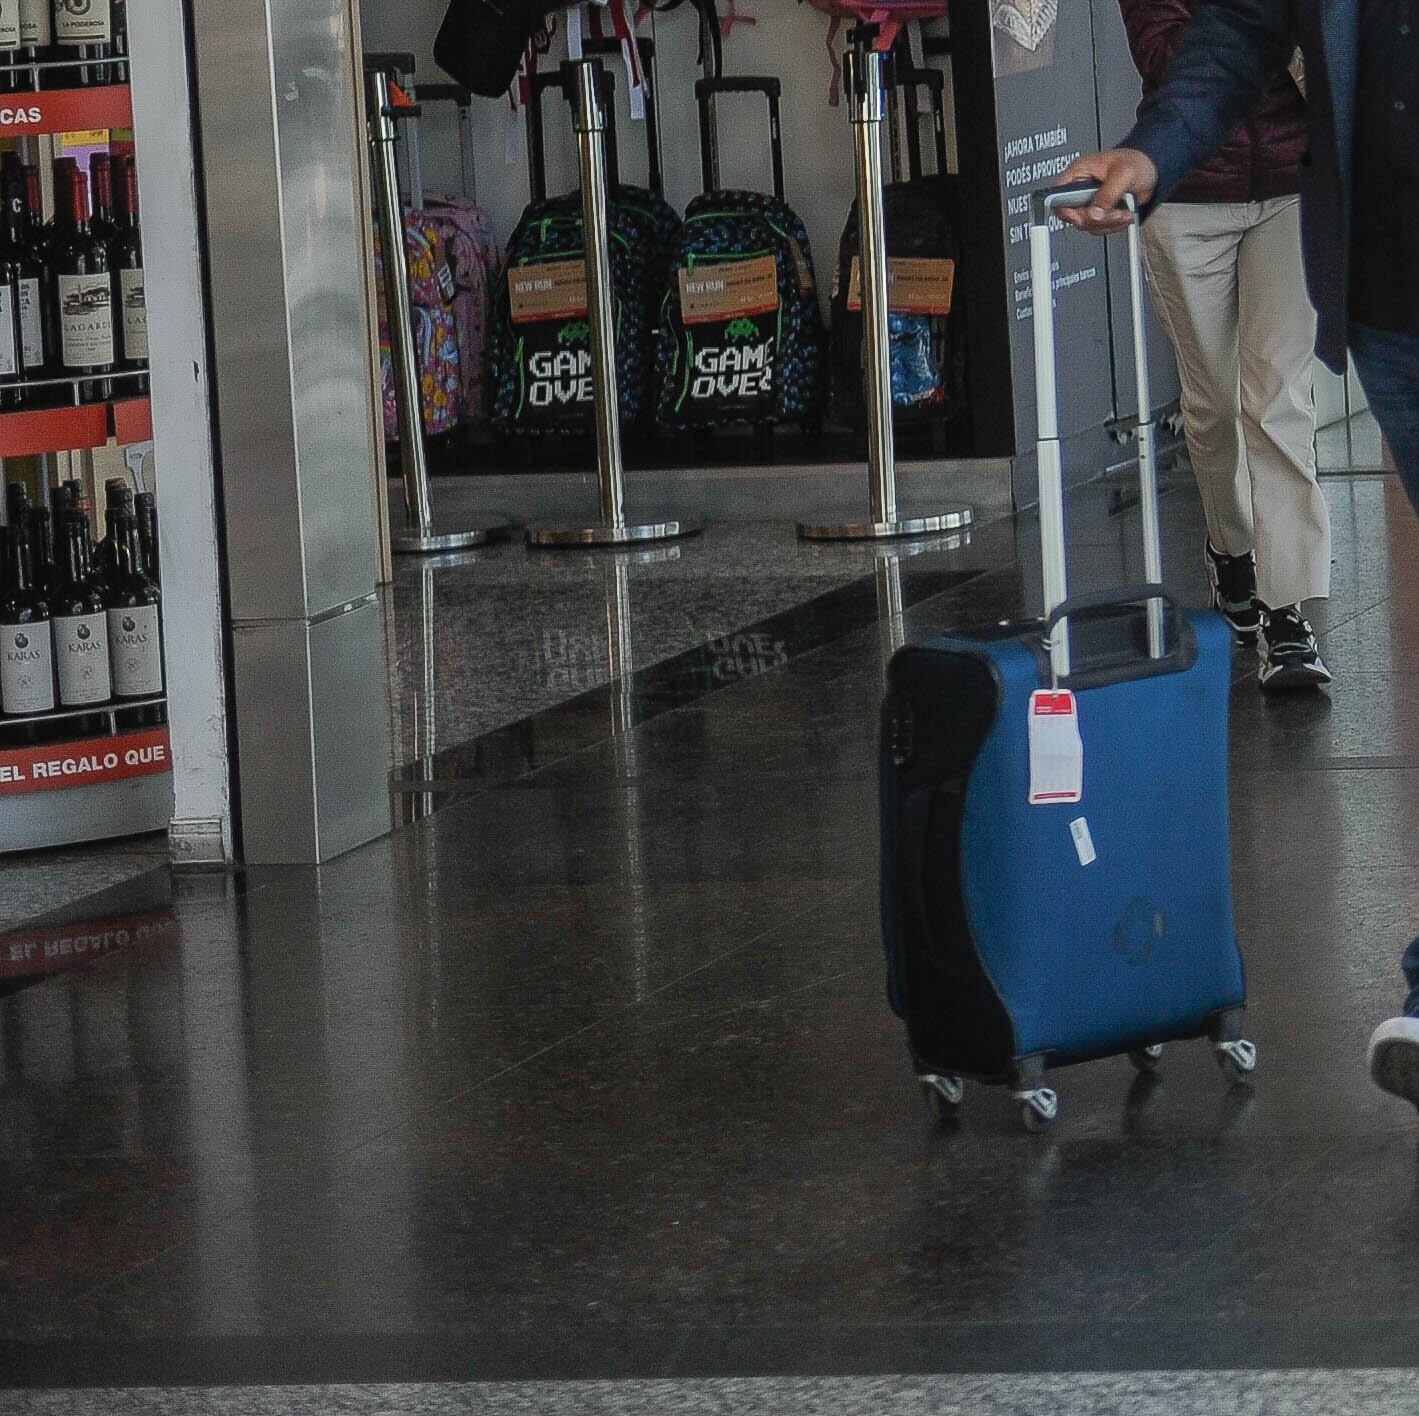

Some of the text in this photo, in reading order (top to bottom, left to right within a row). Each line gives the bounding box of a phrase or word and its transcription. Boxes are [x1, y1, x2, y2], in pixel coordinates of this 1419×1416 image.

[0, 107, 42, 124] CAS
[68, 641, 101, 653] KARAS
[8, 649, 41, 661] KARAS
[0, 744, 166, 782] EL REGALO QUE
